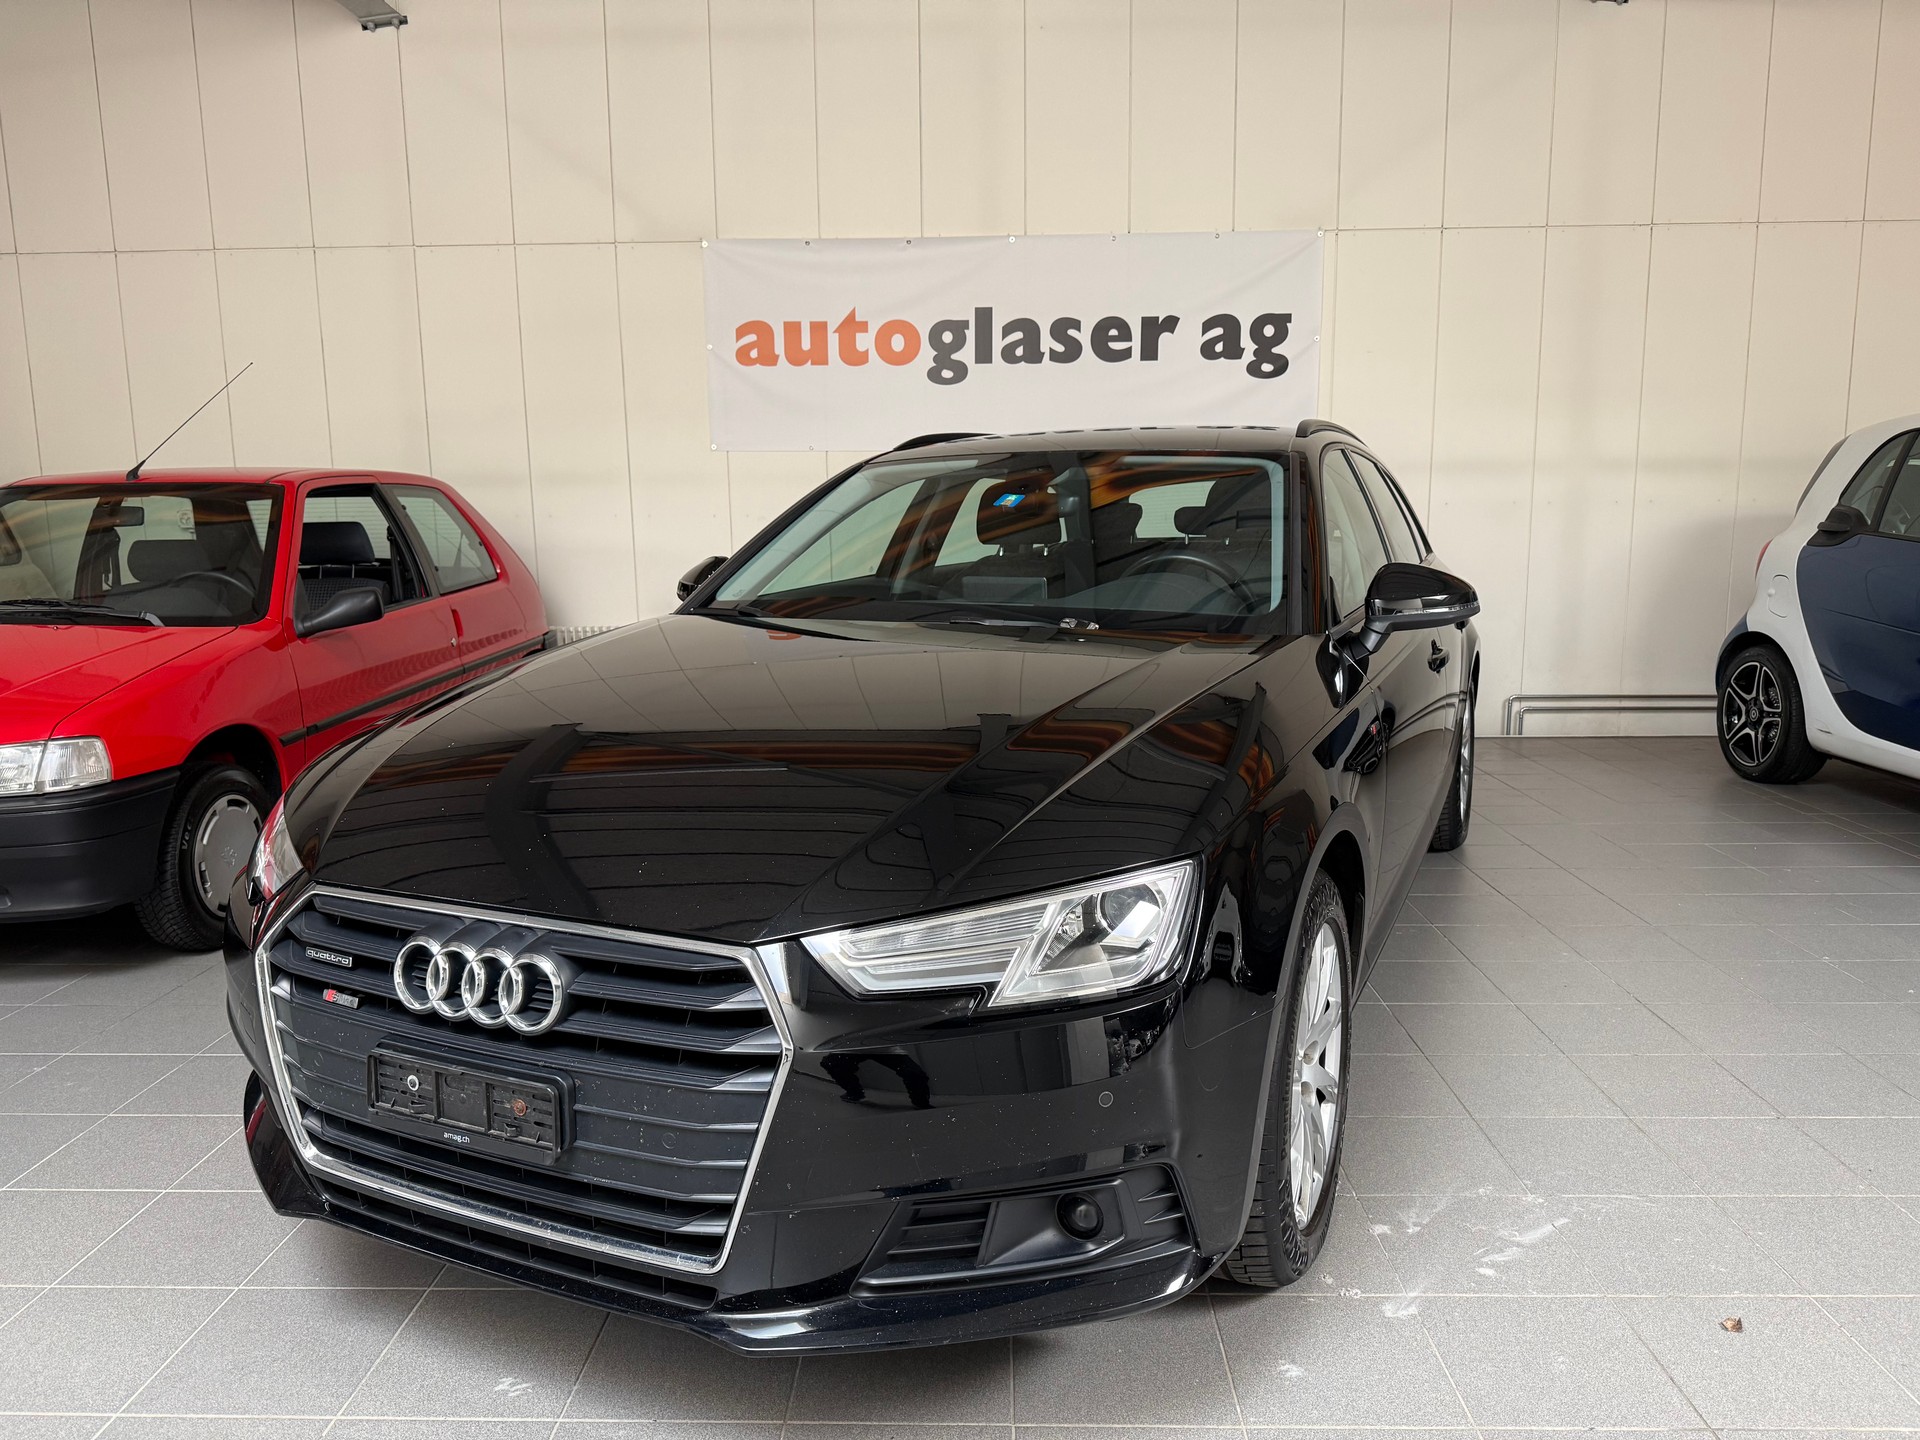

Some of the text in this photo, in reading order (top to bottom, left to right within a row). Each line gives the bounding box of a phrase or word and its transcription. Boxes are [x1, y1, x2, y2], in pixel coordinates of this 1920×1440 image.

[735, 306, 1293, 386] autoglaser ag
[307, 949, 350, 965] quattro
[443, 1131, 470, 1143] amag.ch
